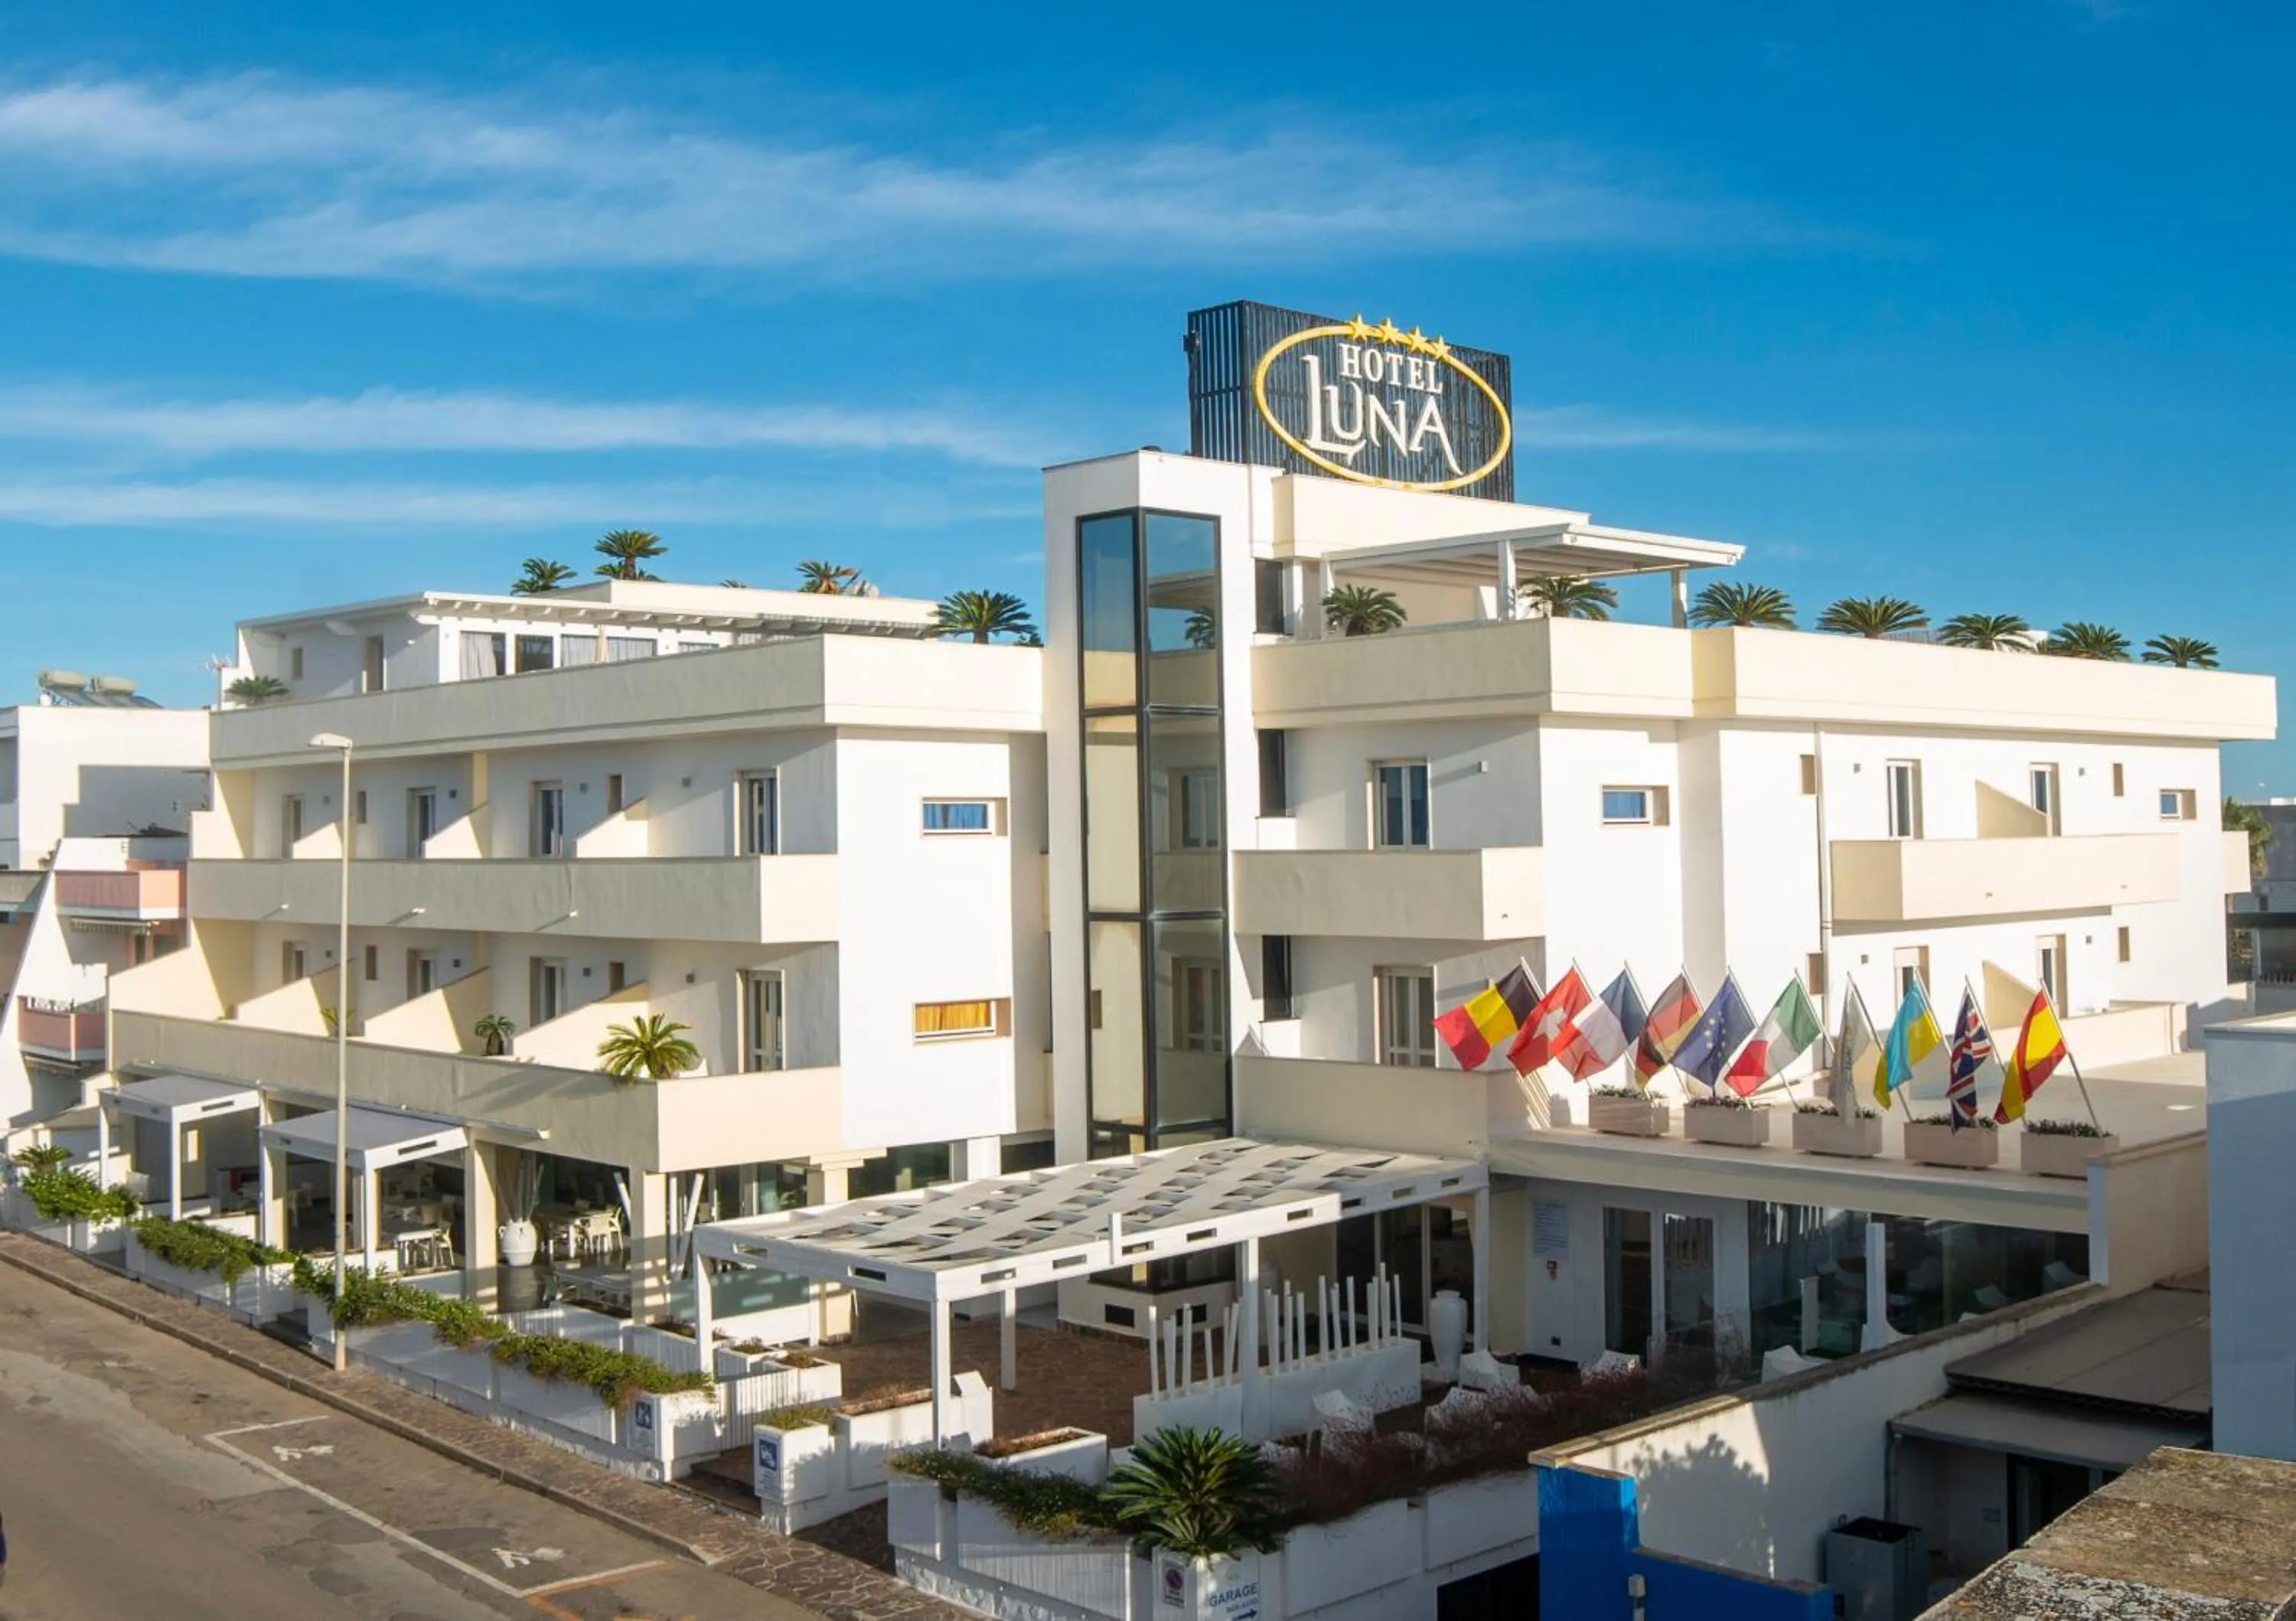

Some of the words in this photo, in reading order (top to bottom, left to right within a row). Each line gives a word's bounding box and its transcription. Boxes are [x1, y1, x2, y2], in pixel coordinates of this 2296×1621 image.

[1339, 343, 1443, 394] HOTEL
[1300, 354, 1463, 475] LUNA
[1209, 1582, 1258, 1606] GARAGE
